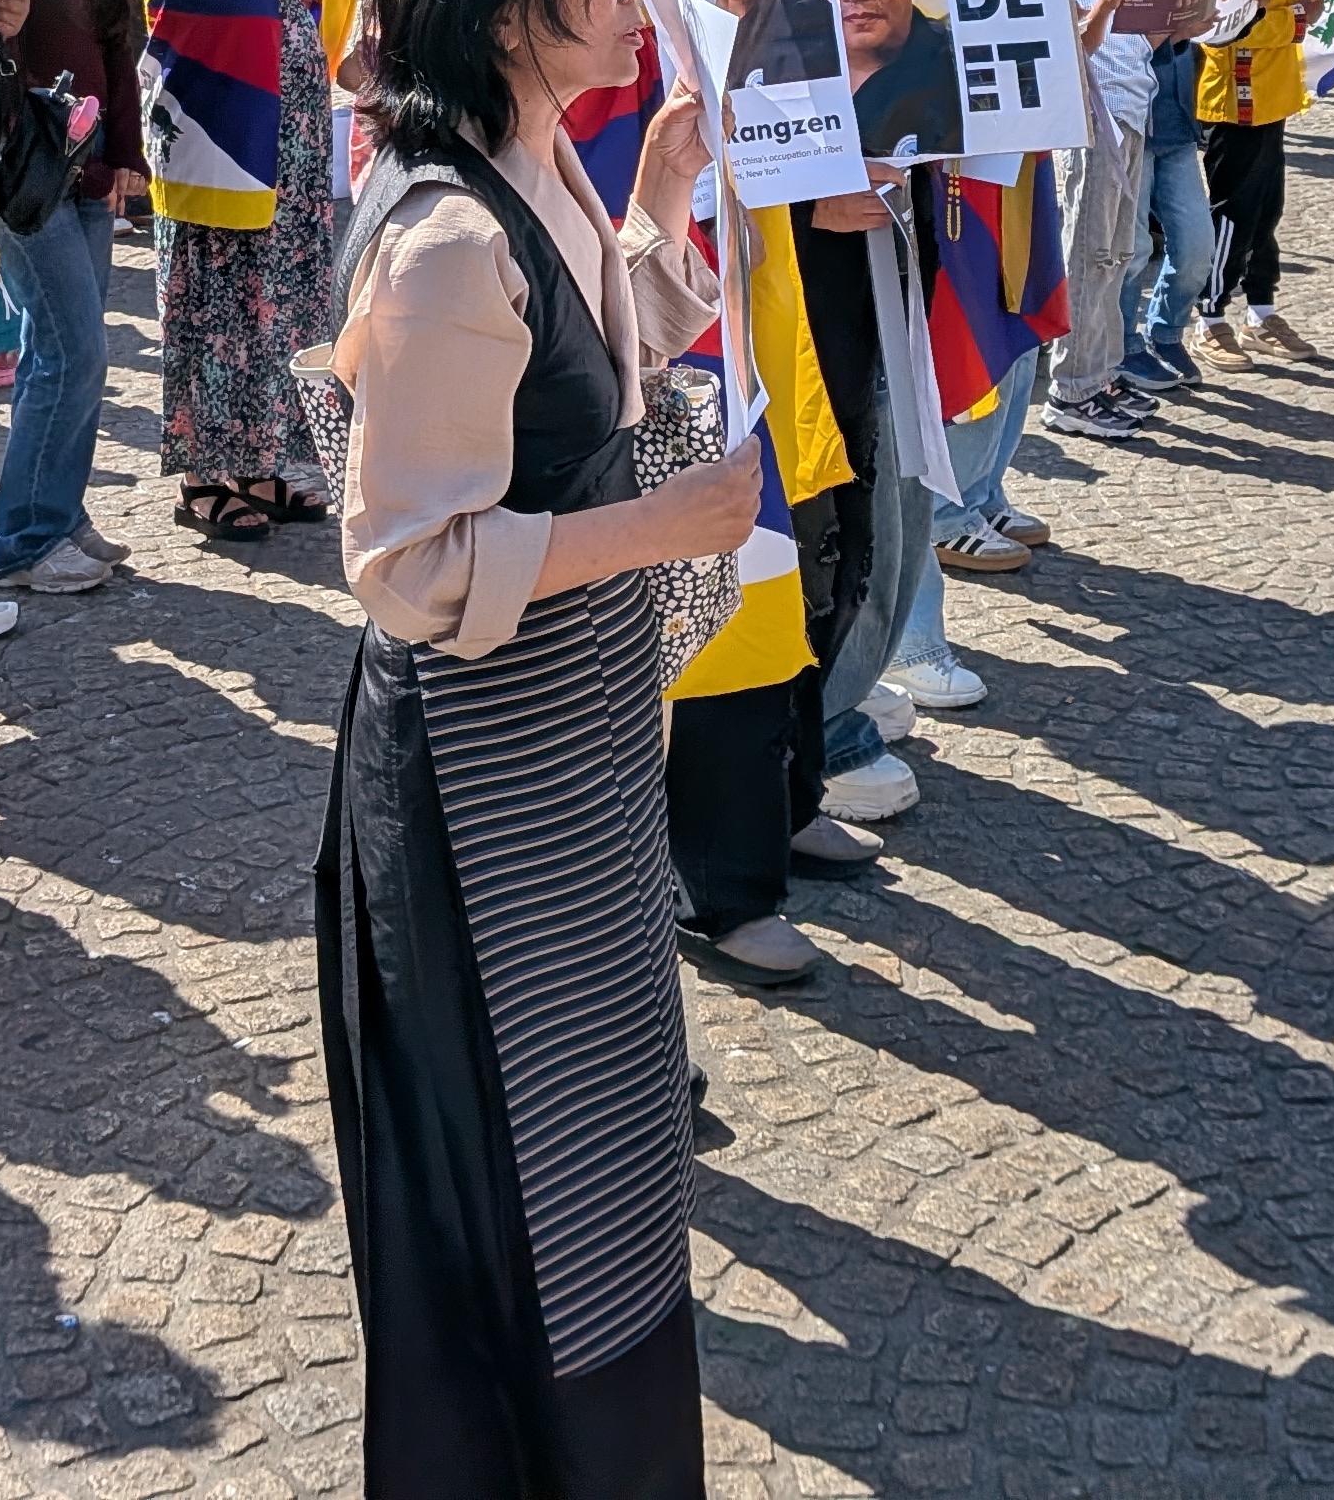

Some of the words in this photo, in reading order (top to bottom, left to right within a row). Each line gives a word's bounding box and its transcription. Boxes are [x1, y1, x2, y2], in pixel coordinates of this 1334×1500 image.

[741, 154, 768, 166] China's
[769, 148, 812, 161] occupation
[813, 146, 821, 156] of
[823, 145, 844, 154] Tibet
[746, 169, 763, 179] New
[764, 166, 782, 176] York
